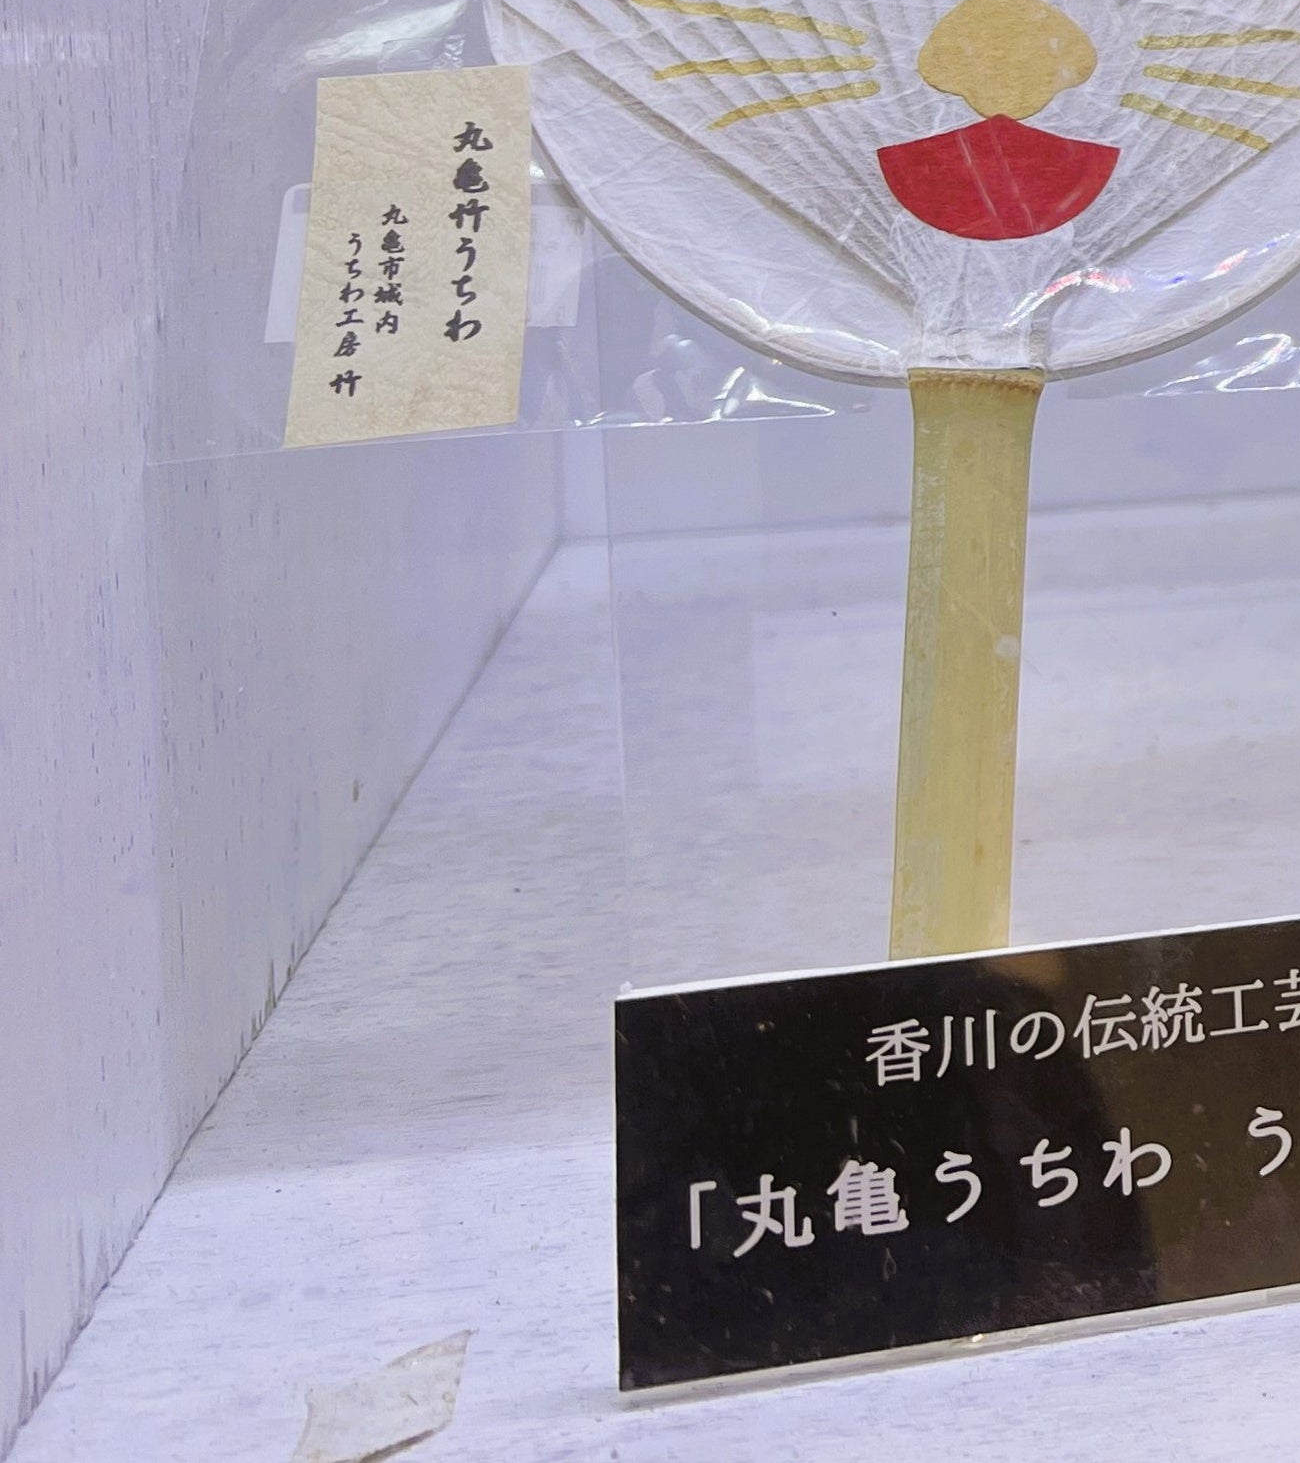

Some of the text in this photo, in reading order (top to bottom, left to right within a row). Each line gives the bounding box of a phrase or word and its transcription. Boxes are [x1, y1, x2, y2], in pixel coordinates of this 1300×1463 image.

[373, 203, 409, 335] 丸亀市城内
